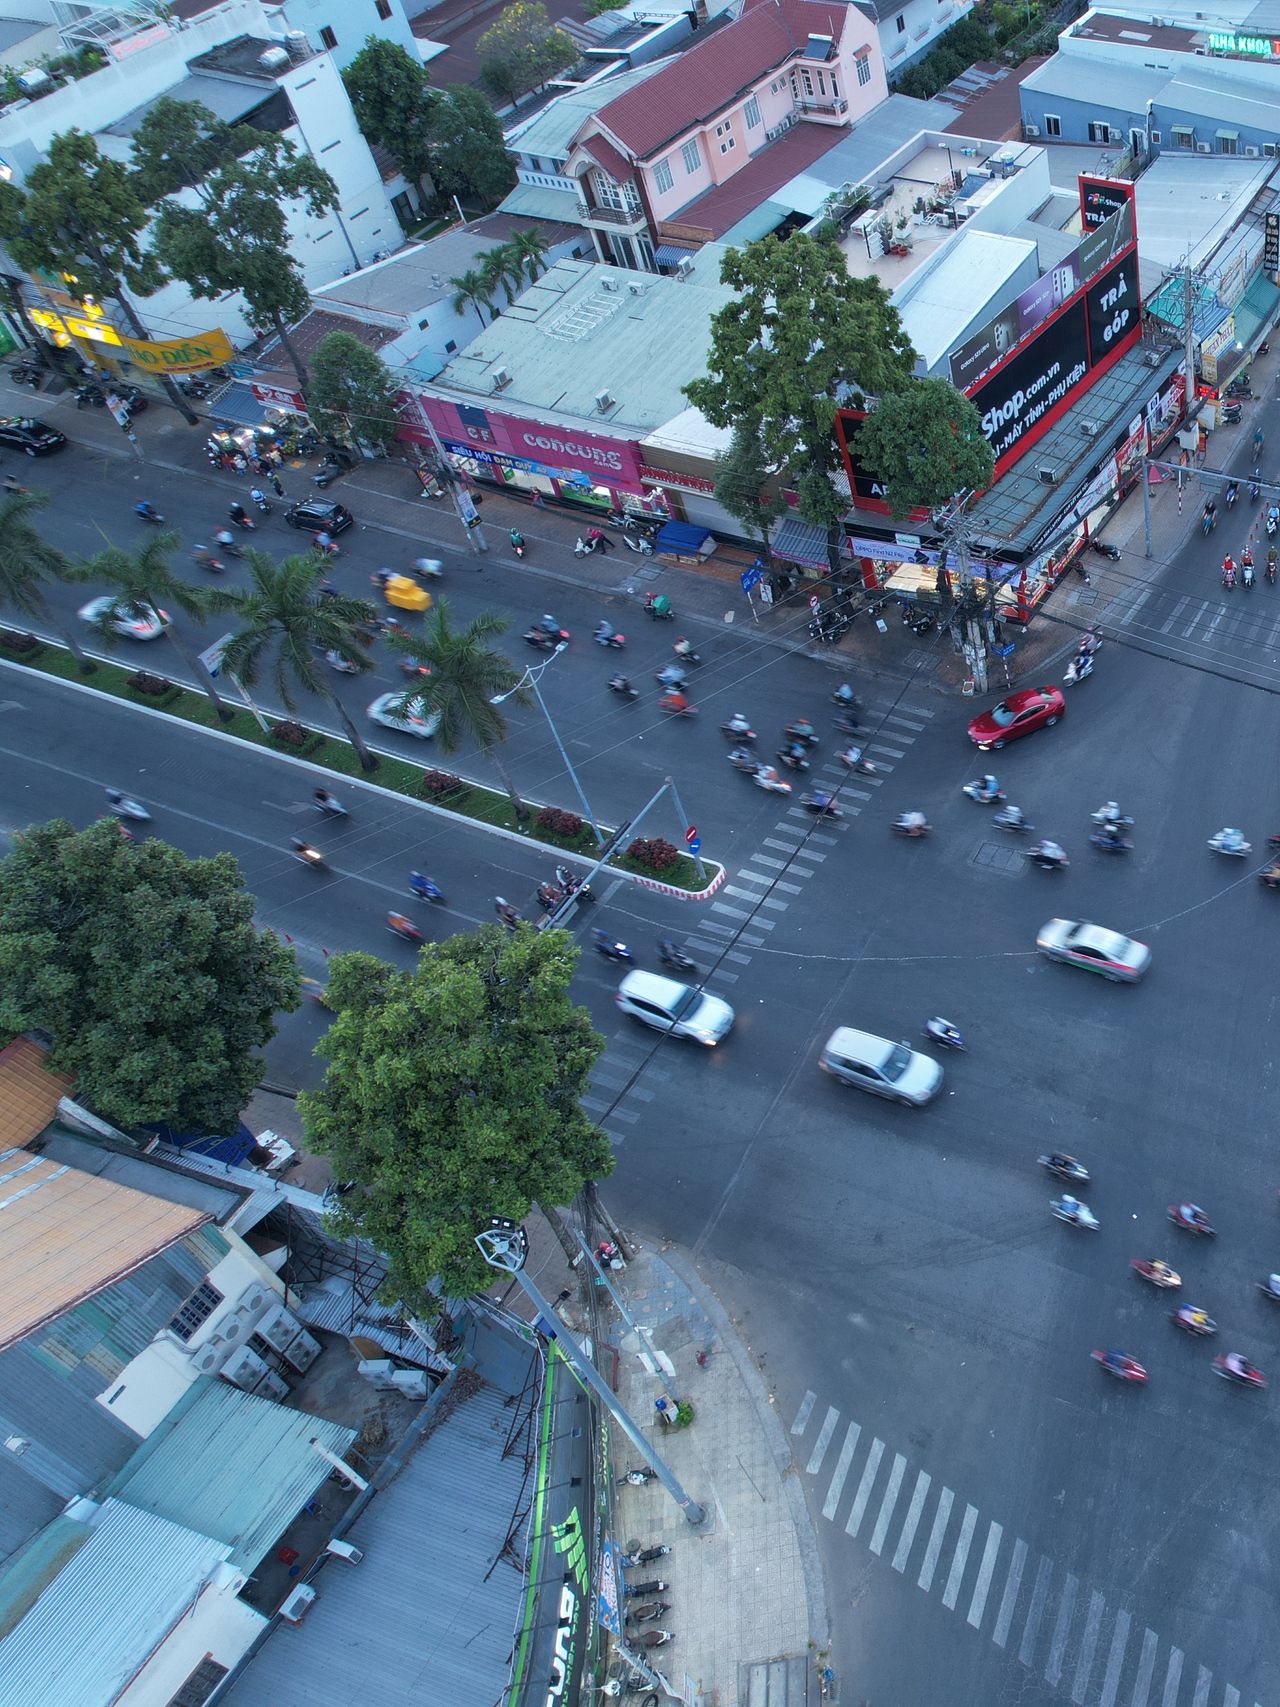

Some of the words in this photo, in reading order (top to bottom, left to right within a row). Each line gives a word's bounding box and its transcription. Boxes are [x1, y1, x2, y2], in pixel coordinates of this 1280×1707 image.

[1237, 36, 1272, 55] KHOA
[1100, 273, 1128, 312] TRẢ
[1103, 308, 1130, 343] GÓP
[1003, 422, 1025, 448] MÁY
[1023, 400, 1046, 427] TÍNH
[1065, 360, 1087, 392] KIỆN
[452, 445, 473, 457] SIÊU
[475, 448, 492, 463] HỘI
[546, 1586, 576, 1707] ung
